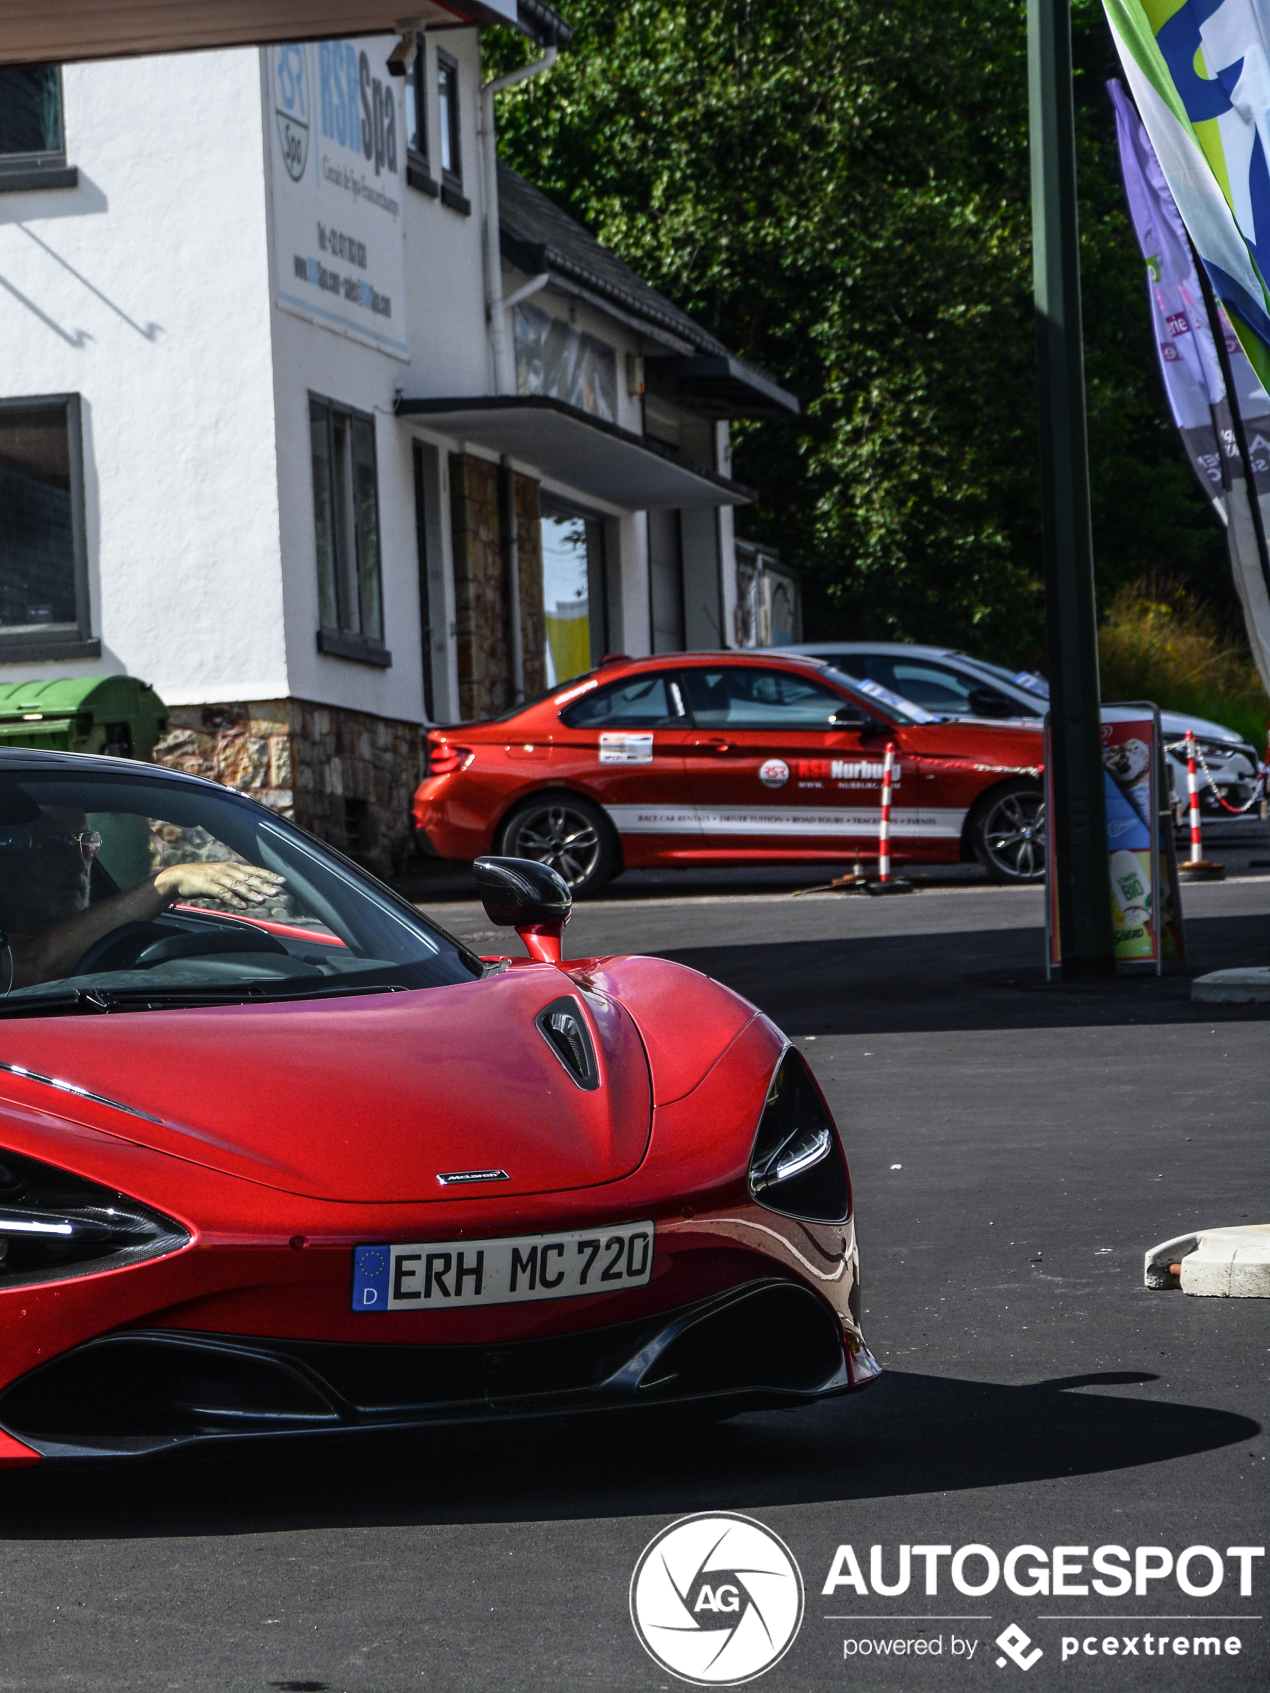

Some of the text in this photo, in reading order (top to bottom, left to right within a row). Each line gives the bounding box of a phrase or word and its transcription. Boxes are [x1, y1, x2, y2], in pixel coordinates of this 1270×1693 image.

[447, 1173, 498, 1181] McLaren
[393, 1231, 650, 1300] ERH MC 720
[363, 1288, 378, 1305] D
